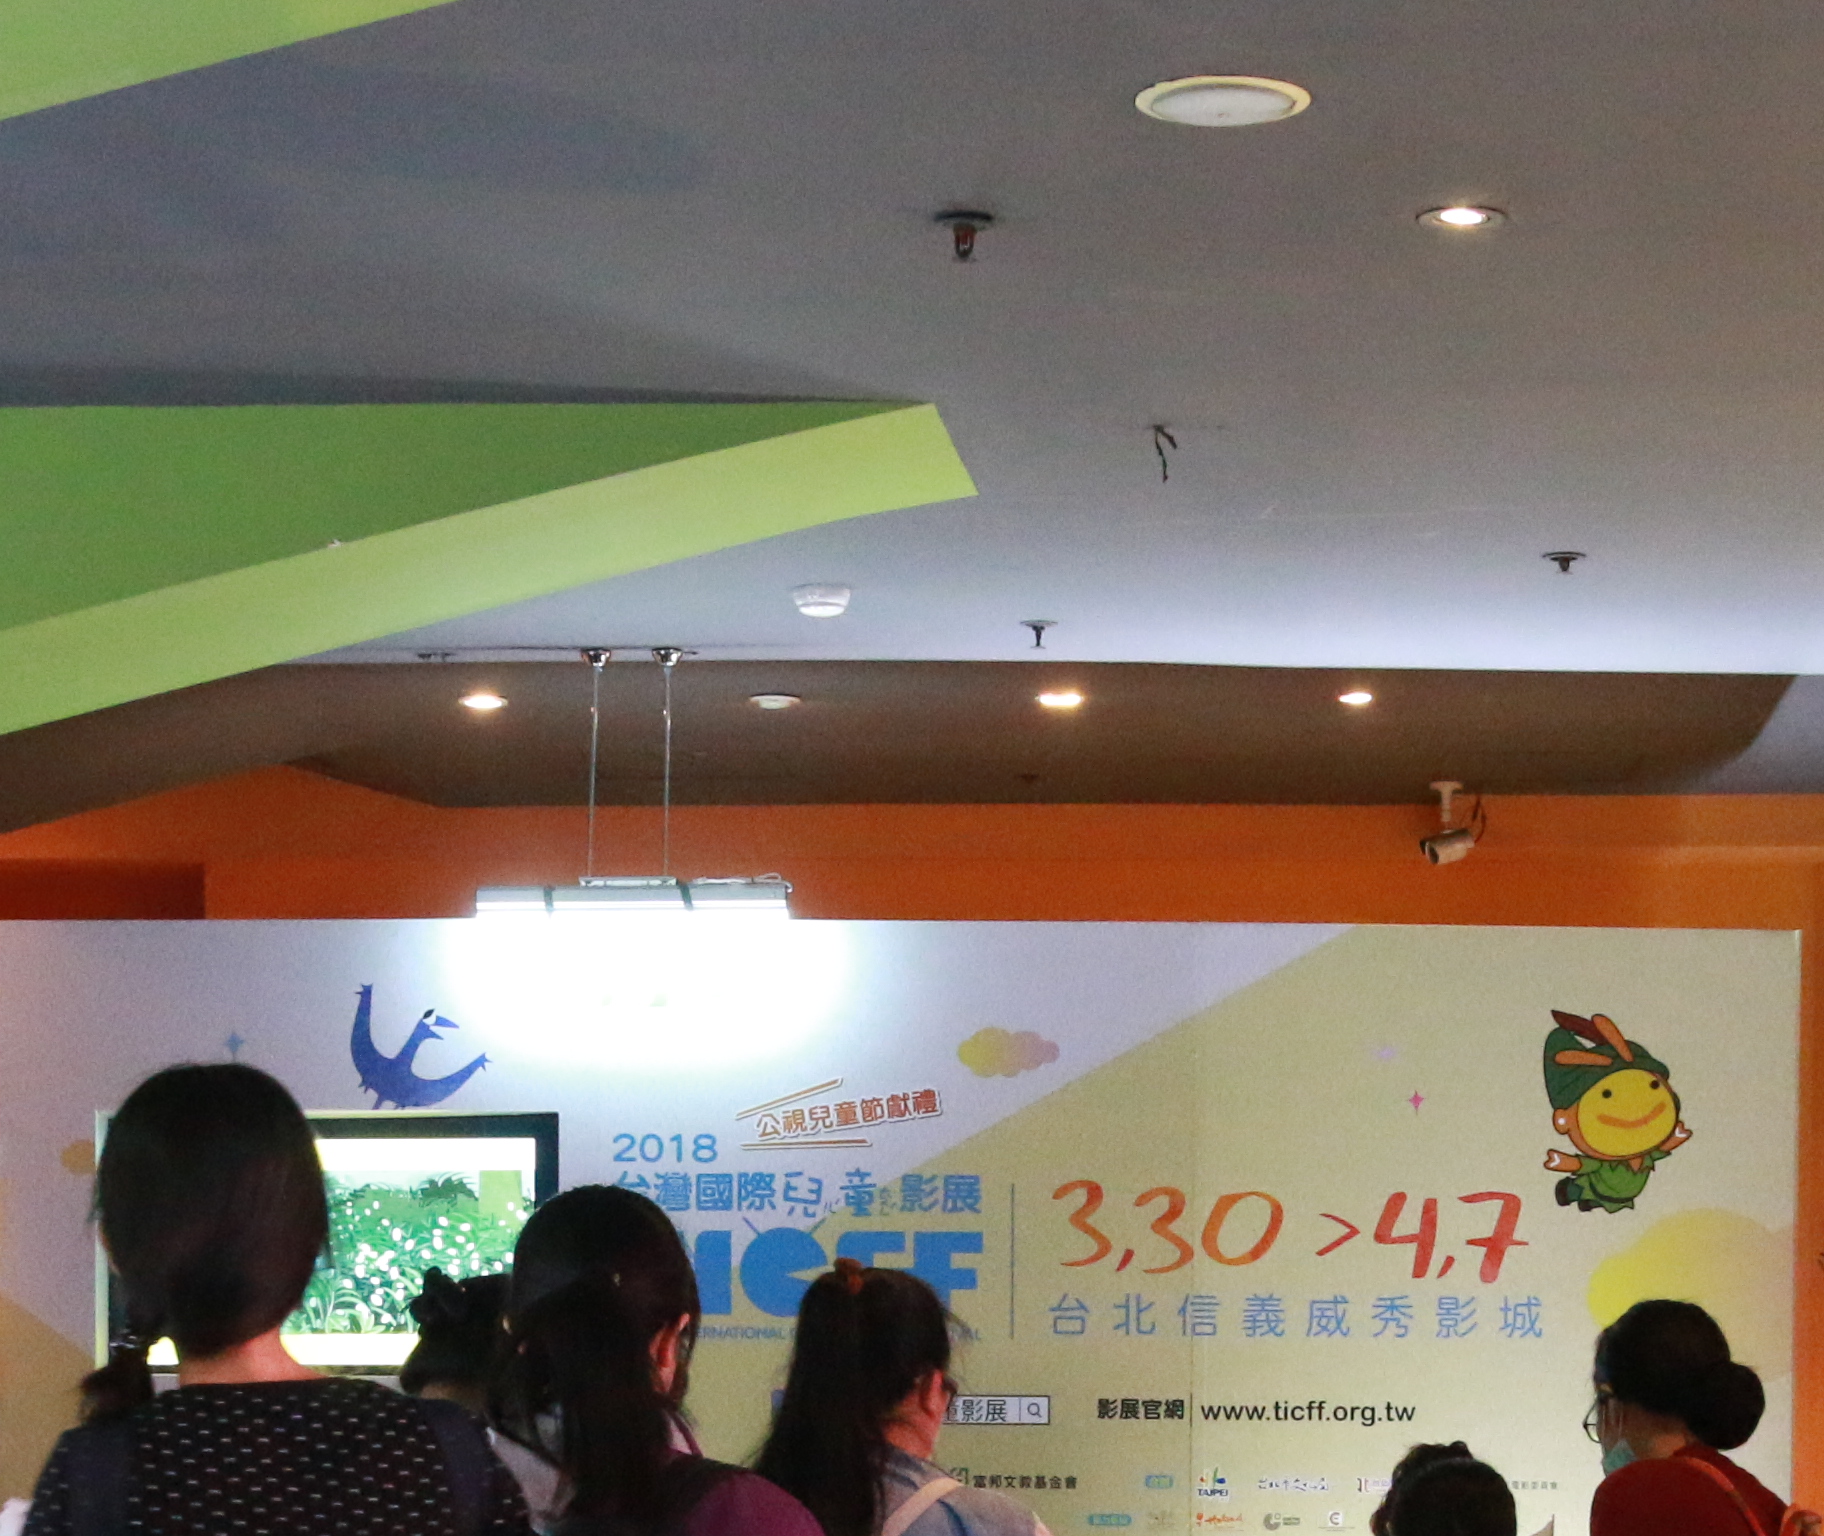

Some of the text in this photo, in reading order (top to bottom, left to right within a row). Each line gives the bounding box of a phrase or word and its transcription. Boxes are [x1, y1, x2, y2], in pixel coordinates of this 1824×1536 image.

[756, 1087, 939, 1139] 公視兒童節獻禮
[613, 1133, 717, 1162] 2018
[1048, 1293, 1544, 1339] 台北信義威秀影城
[1097, 1399, 1185, 1420] 影展官網
[1201, 1401, 1416, 1426] www.ticff.org.tw
